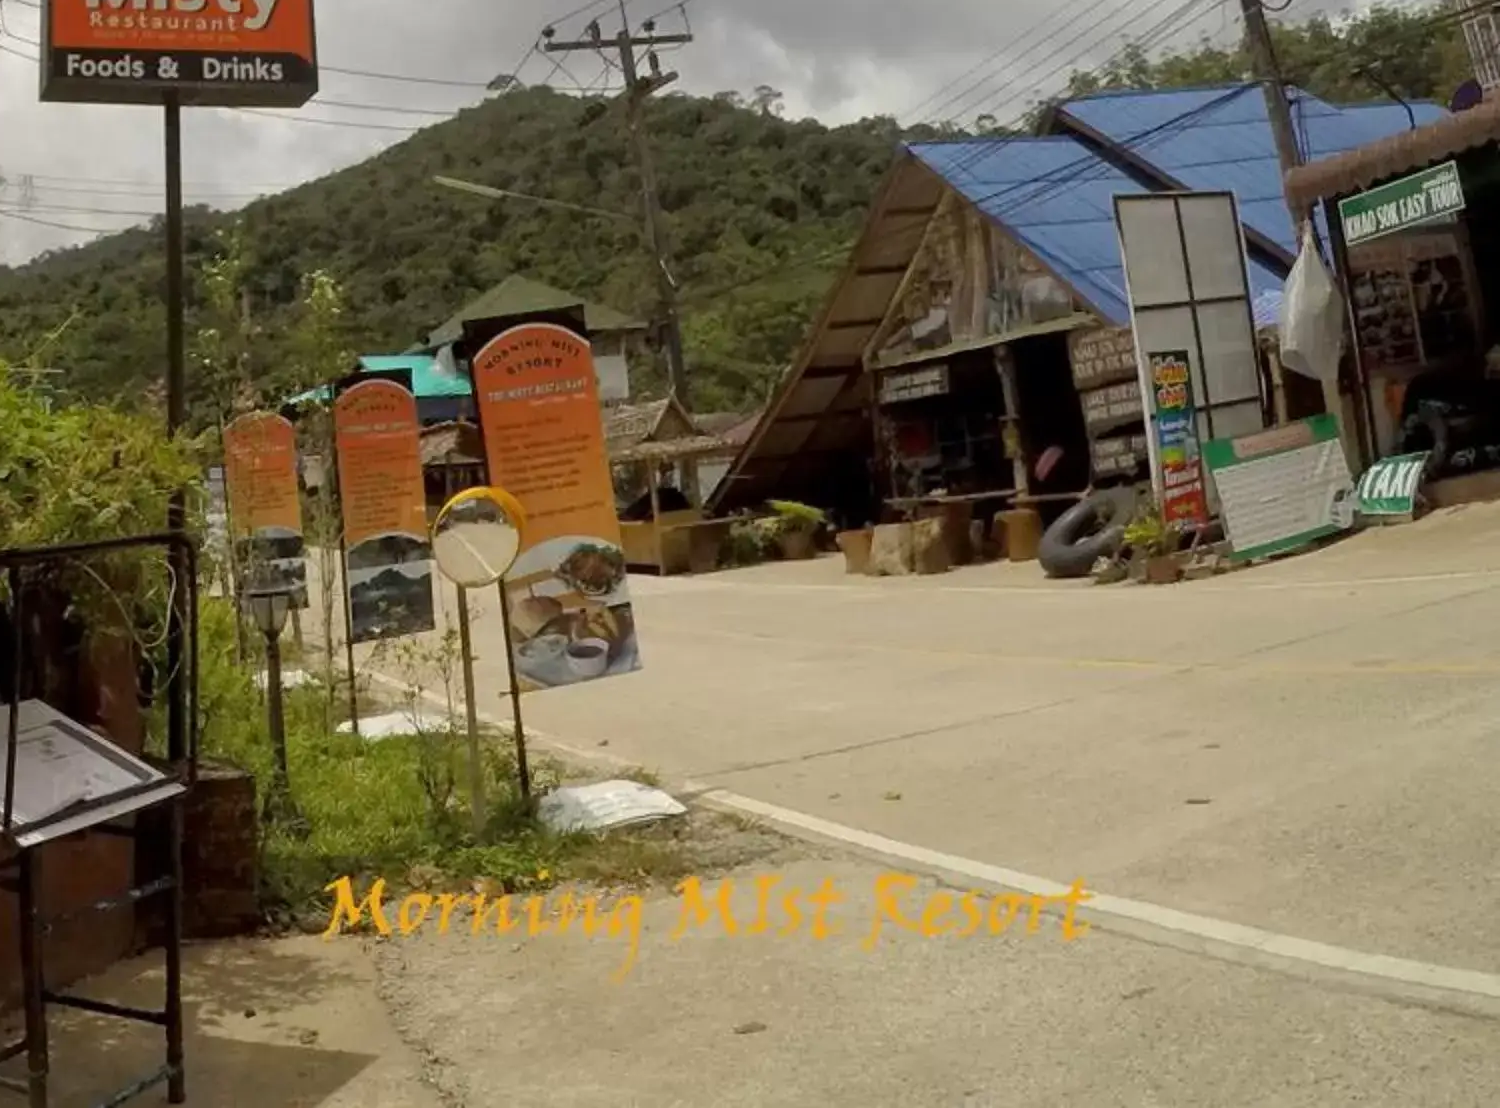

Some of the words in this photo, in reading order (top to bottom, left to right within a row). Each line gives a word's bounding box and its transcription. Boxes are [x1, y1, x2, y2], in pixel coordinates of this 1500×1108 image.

[89, 11, 237, 31] Restaurant
[66, 54, 145, 78] Foods
[157, 55, 180, 79] &
[202, 57, 283, 80] Drinks
[1362, 460, 1423, 500] TAXI
